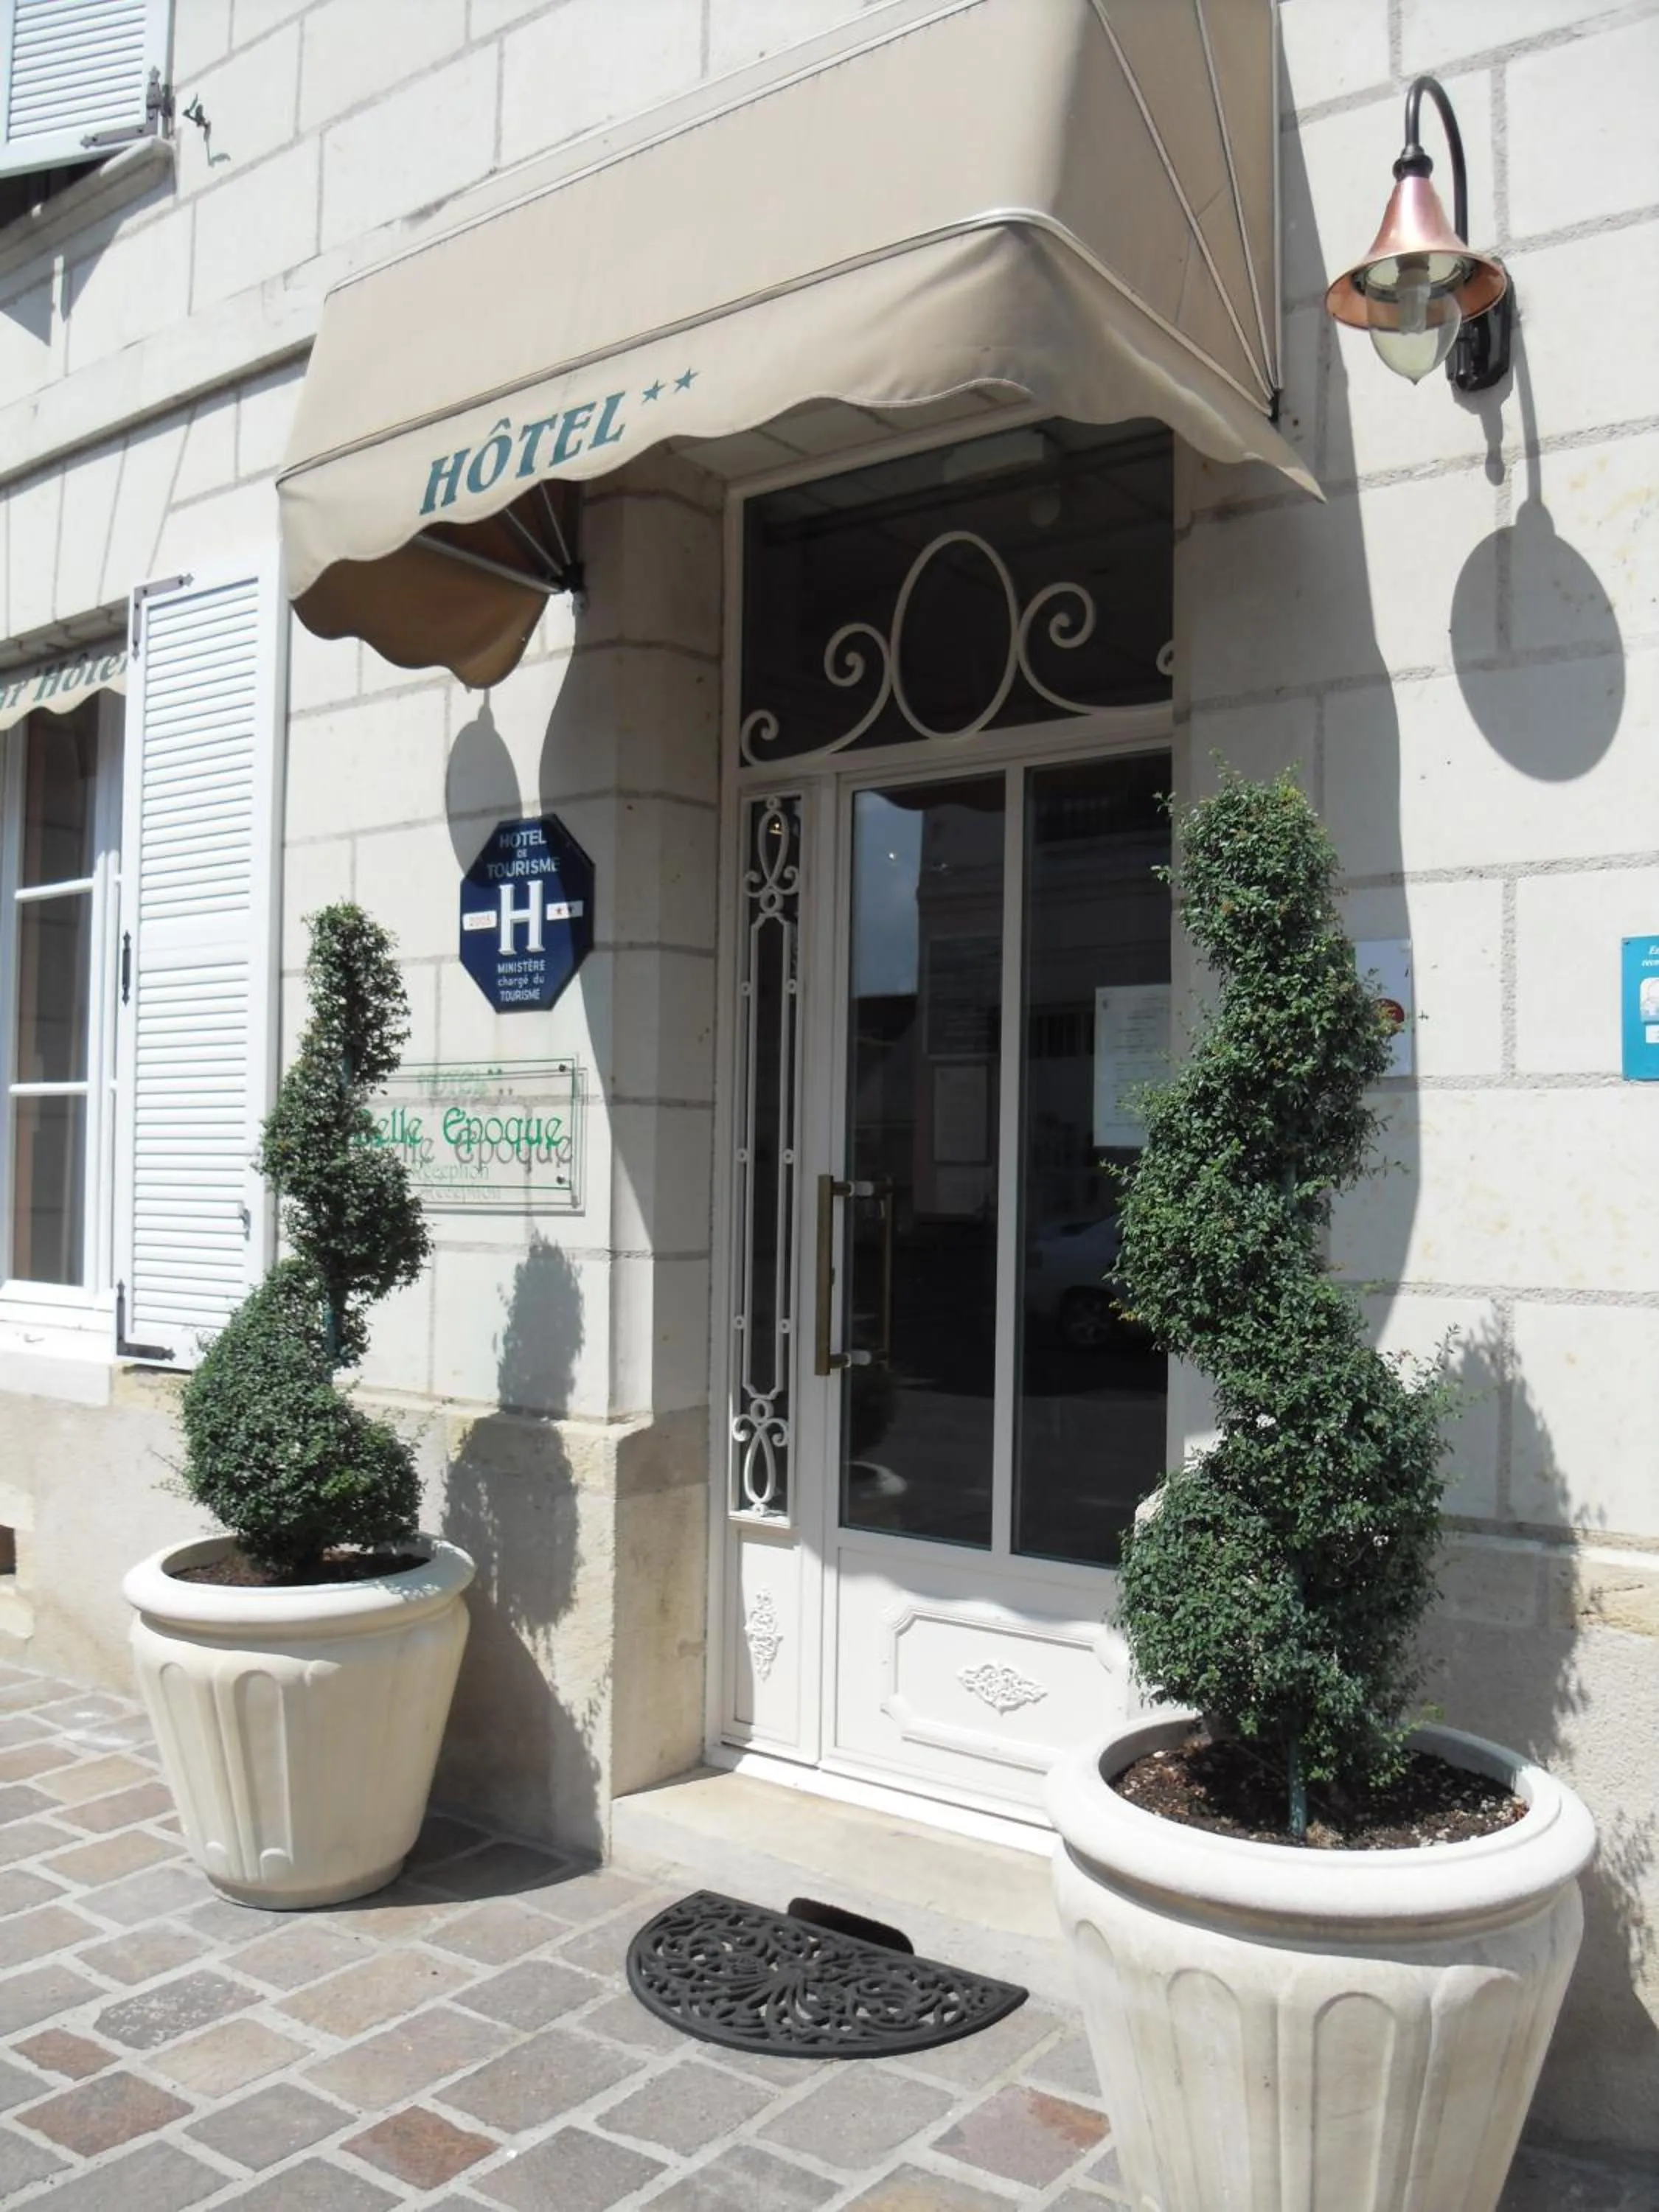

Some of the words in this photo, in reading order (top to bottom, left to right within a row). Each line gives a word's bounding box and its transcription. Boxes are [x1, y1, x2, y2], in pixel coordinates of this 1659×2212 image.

[420, 391, 626, 515] HÔTEL
[499, 827, 547, 849] HOTEL
[487, 855, 560, 880] TOURISME
[498, 880, 545, 956] H
[533, 973, 546, 985] du
[499, 987, 540, 1003] TOURISME
